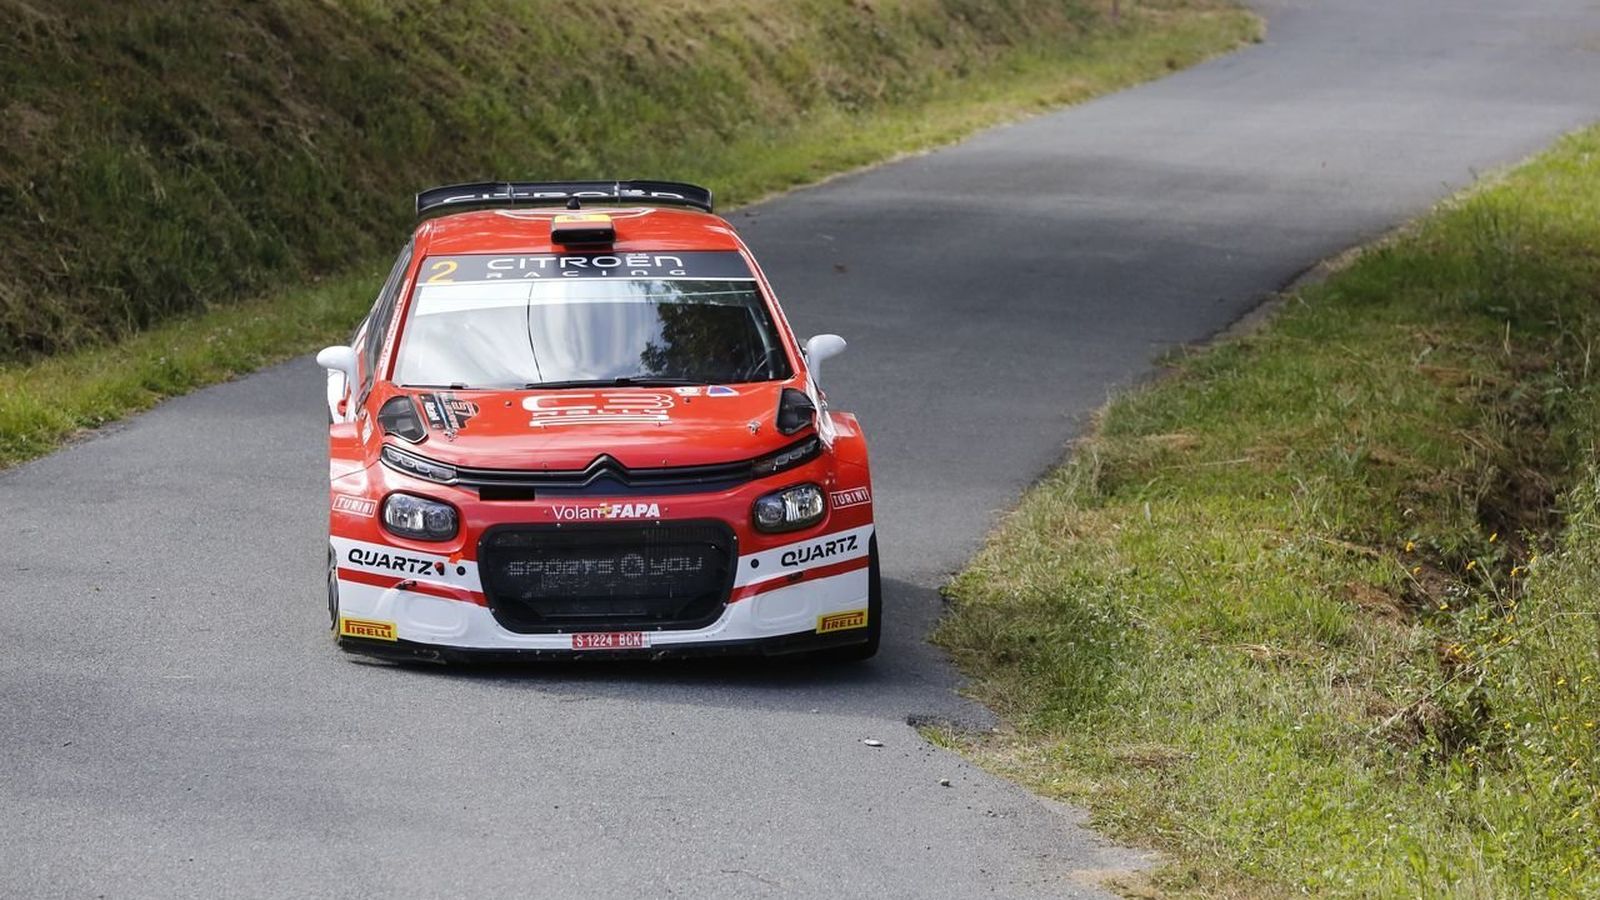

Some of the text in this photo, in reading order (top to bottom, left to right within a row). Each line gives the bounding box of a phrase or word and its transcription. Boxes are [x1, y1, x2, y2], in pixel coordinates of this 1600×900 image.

[430, 261, 457, 283] 2
[522, 393, 675, 411] C3
[337, 498, 375, 515] TURINI
[833, 490, 869, 506] TURINI
[781, 535, 858, 568] QUARTZ
[348, 548, 433, 575] QUARTZ
[508, 558, 615, 576] SPORTS
[344, 620, 392, 639] PIRELLI
[821, 611, 864, 631] PIRELLI
[576, 633, 641, 647] S 1224 BCK
